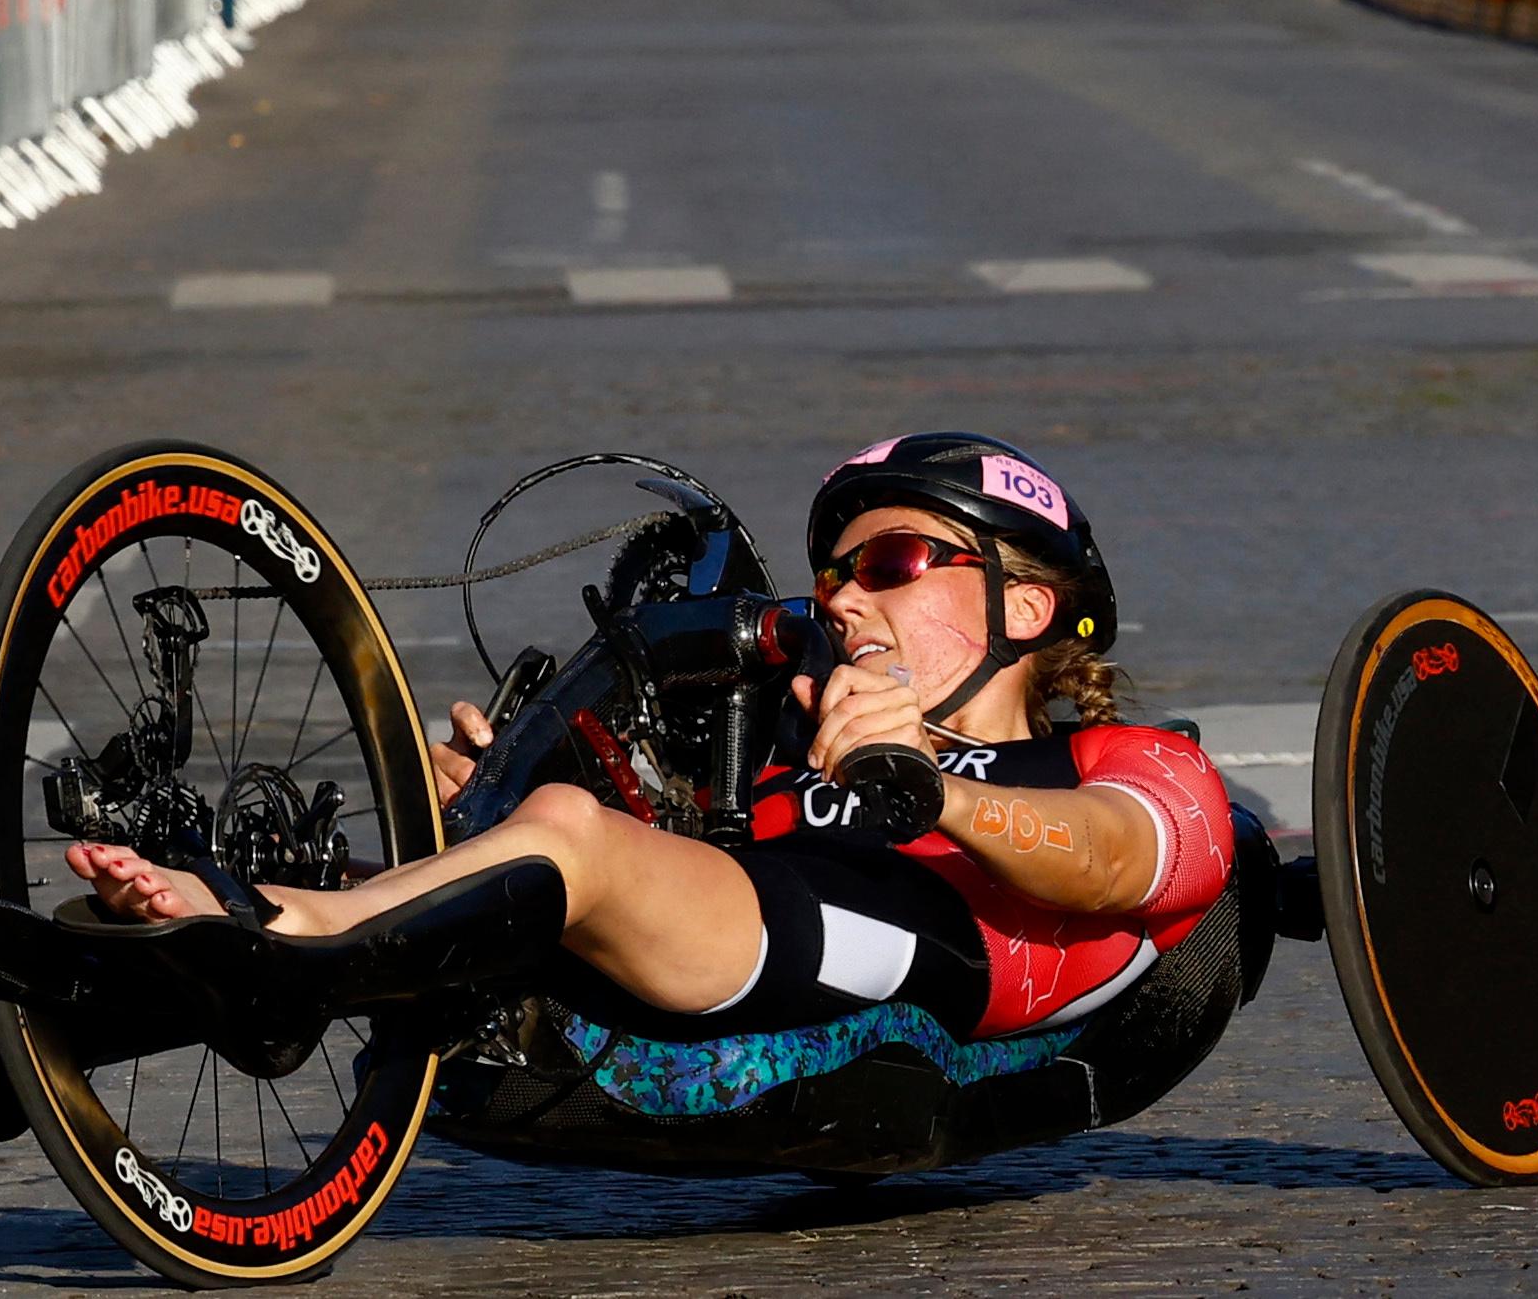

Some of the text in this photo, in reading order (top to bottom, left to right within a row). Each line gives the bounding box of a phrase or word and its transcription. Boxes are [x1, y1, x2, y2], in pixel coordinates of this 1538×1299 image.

[46, 479, 242, 609] carbonbike.usa
[999, 470, 1054, 510] 103
[192, 1121, 390, 1251] carbonbike.usa
